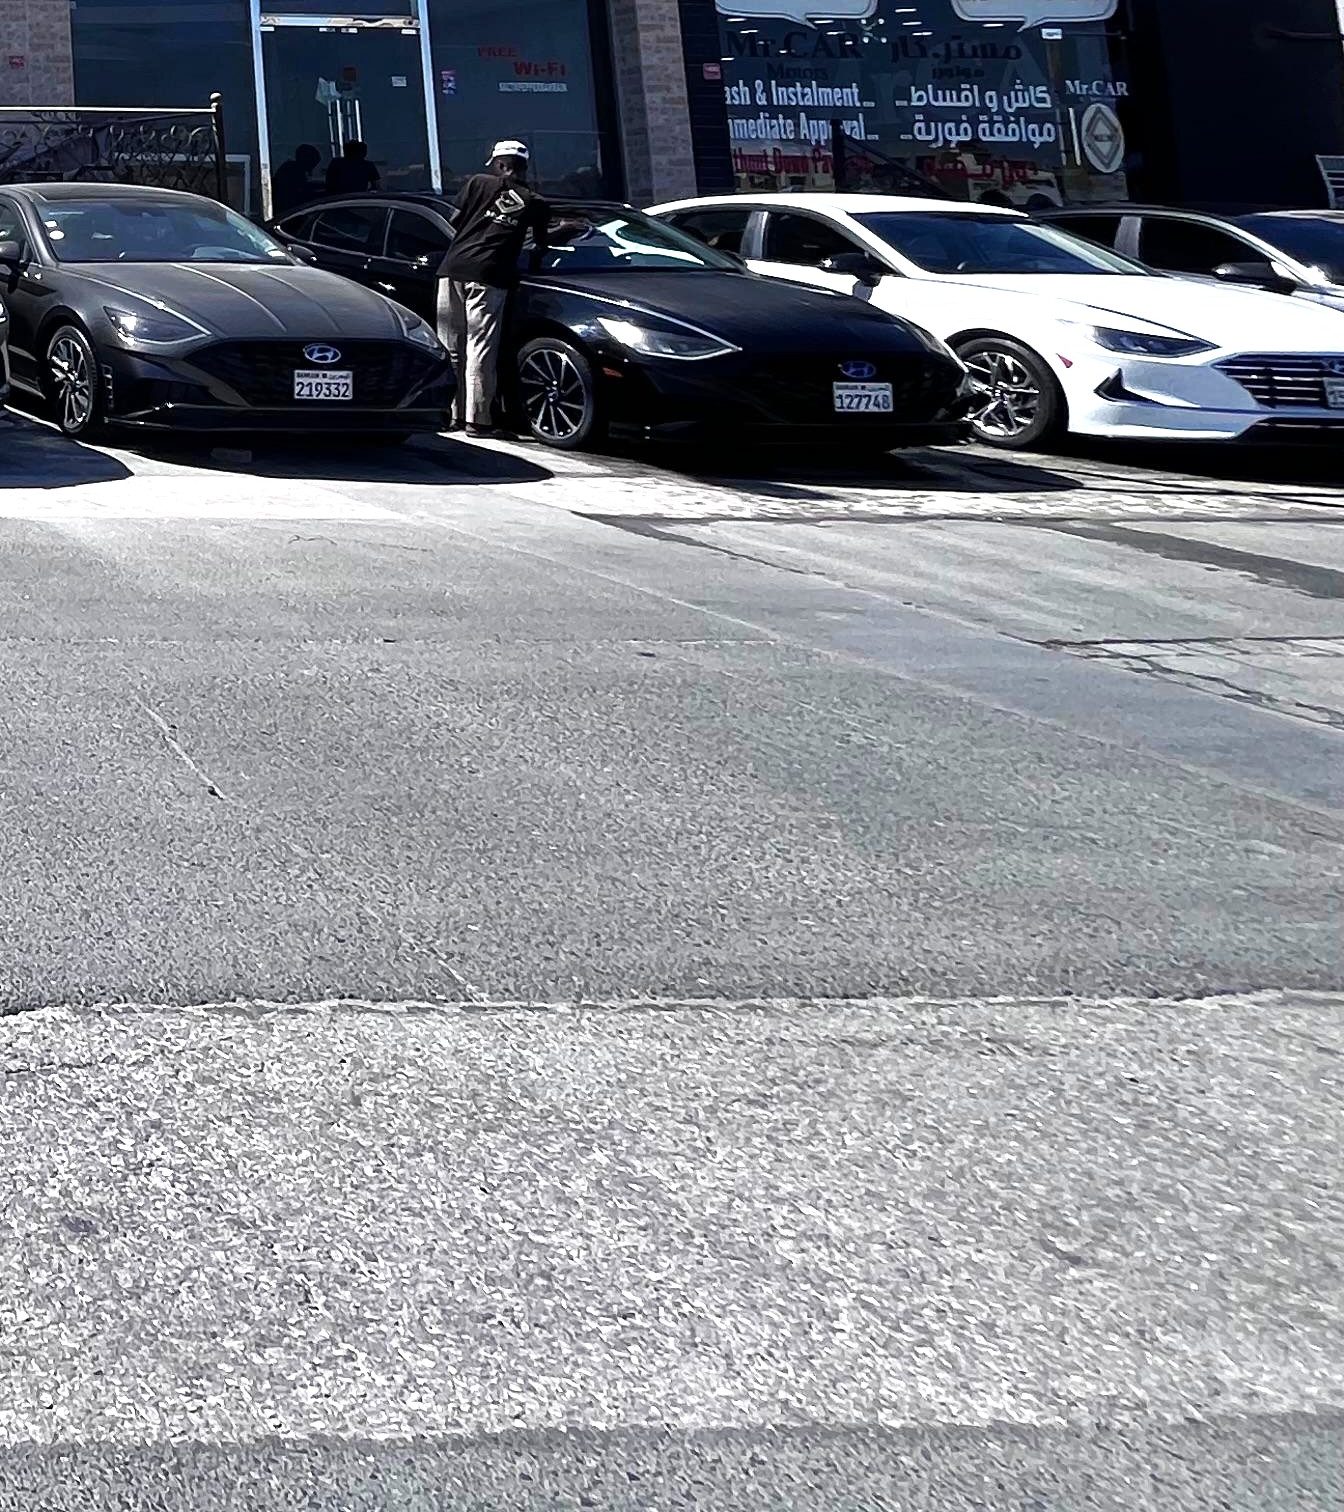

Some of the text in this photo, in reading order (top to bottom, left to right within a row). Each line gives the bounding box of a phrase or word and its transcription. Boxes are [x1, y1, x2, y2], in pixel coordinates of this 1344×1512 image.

[724, 80, 751, 105] ash
[755, 79, 767, 105] &
[1003, 79, 1052, 112] كاش
[1065, 79, 1128, 96] Mr.CAR
[728, 112, 794, 139] mediate
[978, 114, 1056, 149] موافقة
[296, 381, 350, 398] 219332
[835, 393, 891, 410] 127748
